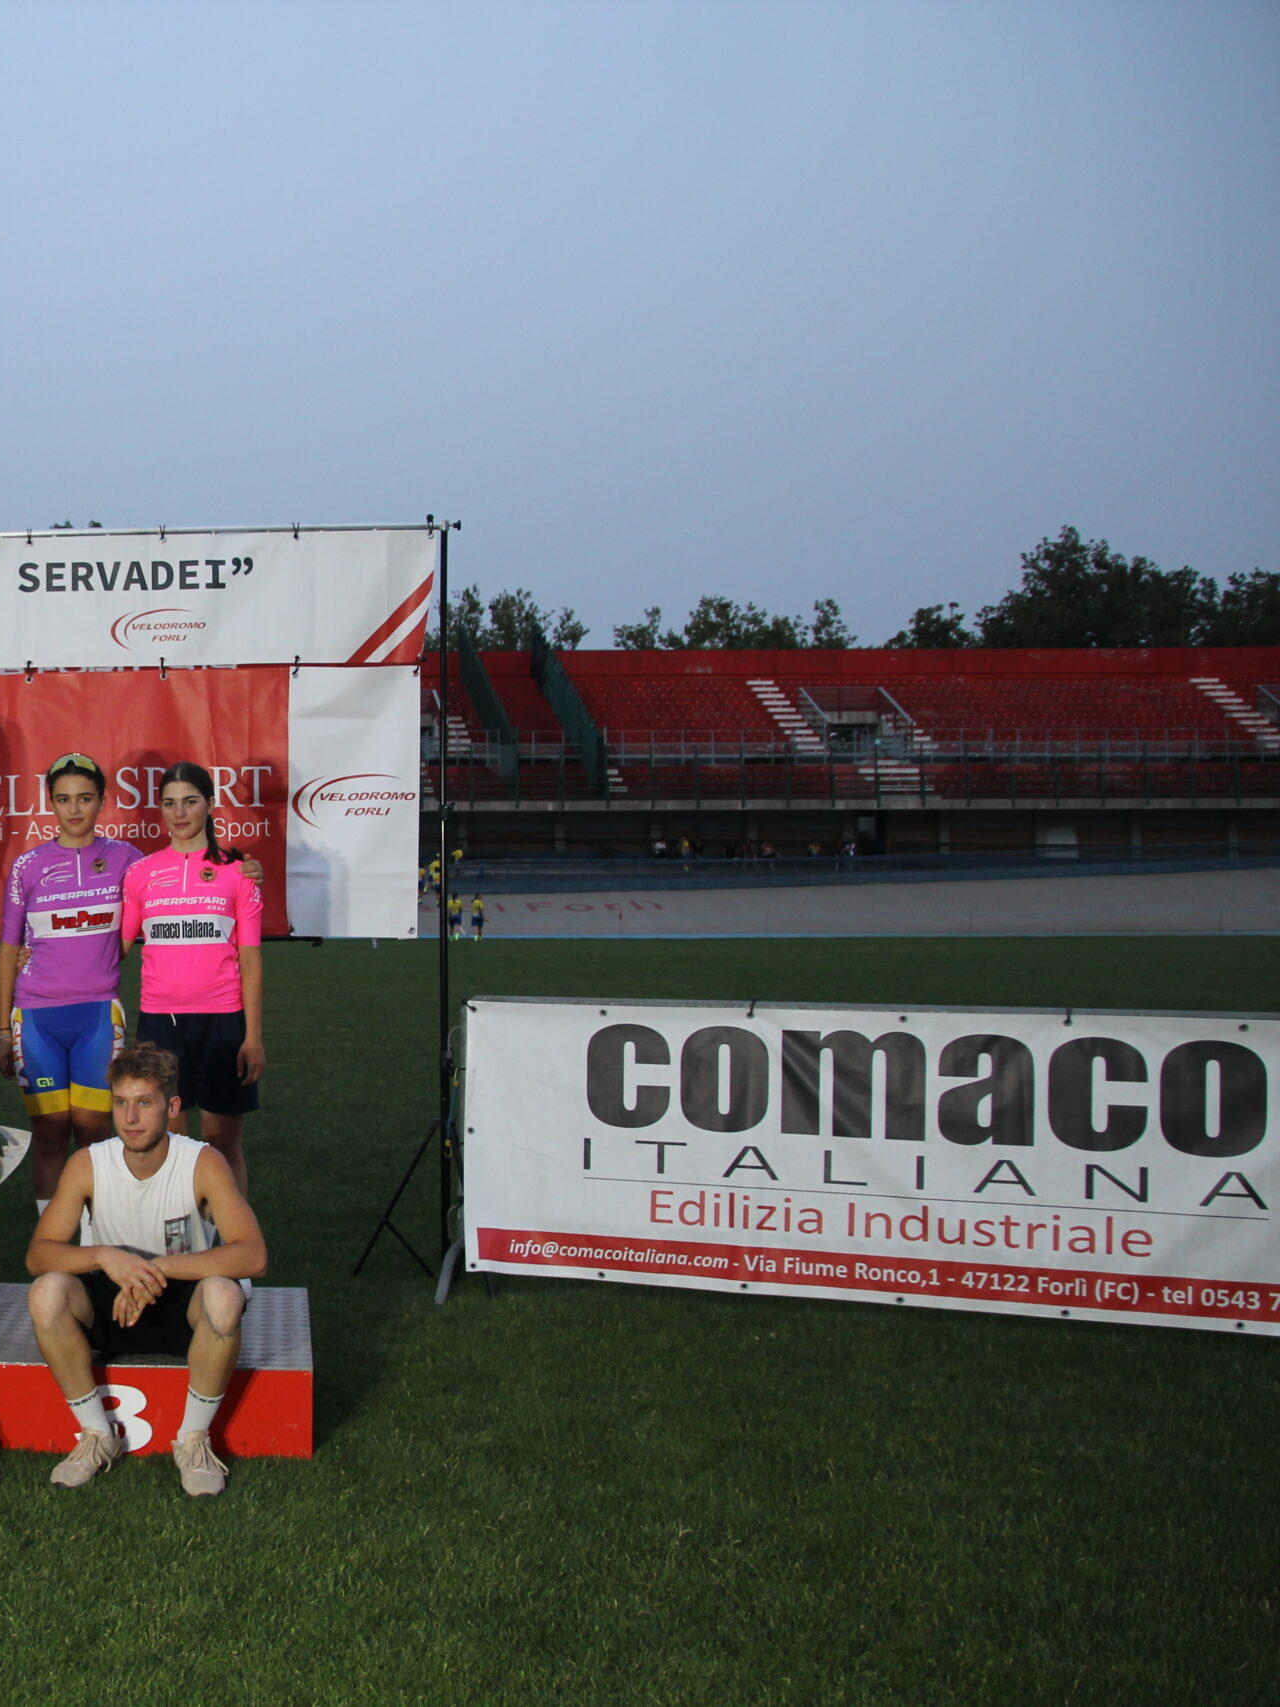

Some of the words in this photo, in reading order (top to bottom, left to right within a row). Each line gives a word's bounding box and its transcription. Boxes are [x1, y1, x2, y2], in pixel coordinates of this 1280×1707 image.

[132, 621, 207, 631] VELODROMO
[152, 634, 187, 642] FORLI
[116, 766, 272, 810] SPRT
[320, 792, 416, 801] VELODROMO
[345, 807, 391, 816] FORLI
[26, 820, 160, 841] Asssorato
[213, 818, 271, 842] Sport
[145, 896, 227, 909] SUPERPISTARD
[182, 920, 214, 938] italiana
[586, 1023, 1268, 1158] comaco
[583, 1138, 1270, 1211] ITALIANA
[648, 1188, 823, 1236] Edilizia
[847, 1200, 1154, 1257] Industriale
[509, 1238, 729, 1270] info@comacoitaliana.com
[744, 1254, 777, 1273] Via
[783, 1257, 848, 1279] Fiume
[854, 1262, 941, 1288] Ronco,1
[961, 1271, 1030, 1294] 47122
[1037, 1276, 1088, 1297] Forlì
[1095, 1278, 1139, 1305] (FC)
[1161, 1285, 1193, 1305] tel
[1200, 1288, 1261, 1310] 0543
[74, 1384, 153, 1453] 3
